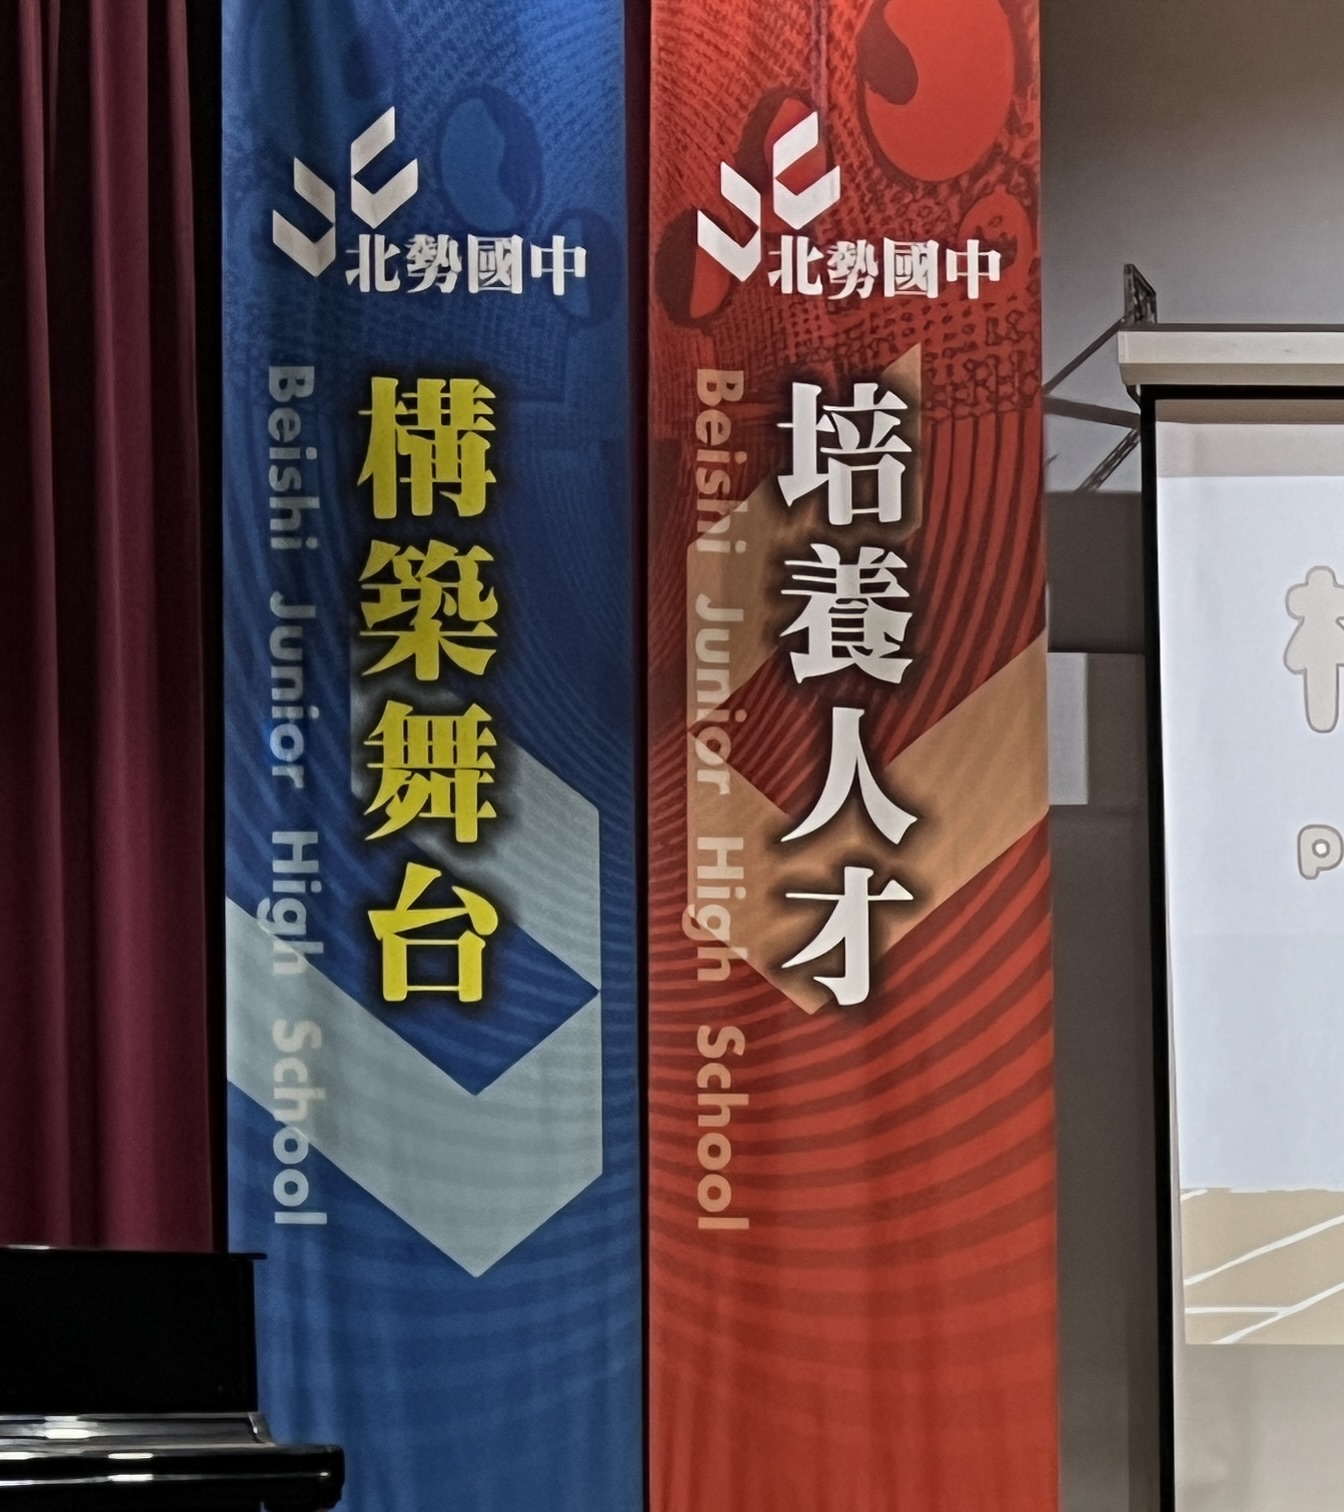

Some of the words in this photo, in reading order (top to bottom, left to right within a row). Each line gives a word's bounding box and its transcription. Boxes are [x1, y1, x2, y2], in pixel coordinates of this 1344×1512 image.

[345, 233, 588, 297] 北勢國中
[767, 234, 1003, 300] 北勢國中
[268, 366, 320, 549] Beishi
[695, 369, 748, 554] Beishi
[269, 591, 320, 789] Junior
[355, 375, 500, 1004] 構築舞台
[695, 594, 748, 795] Junior
[775, 382, 919, 1006] 培養人才
[257, 831, 323, 976] High
[681, 837, 748, 981] High
[272, 1019, 328, 1225] School
[697, 1025, 750, 1230] School
